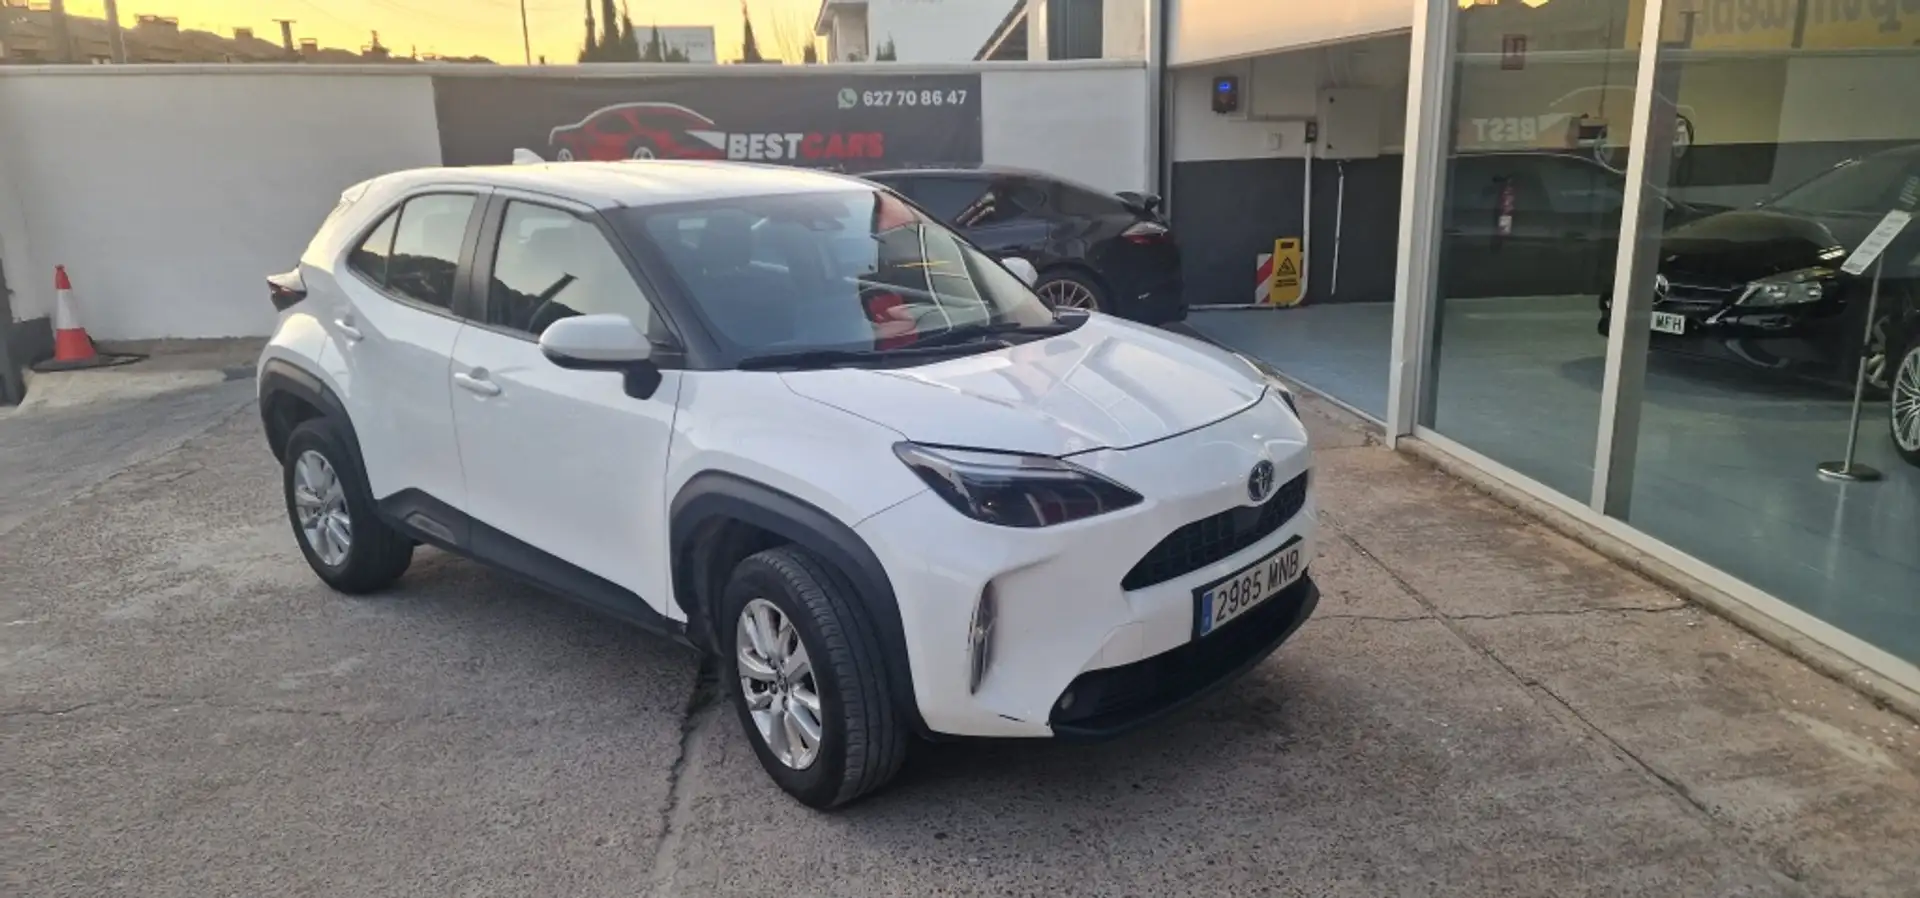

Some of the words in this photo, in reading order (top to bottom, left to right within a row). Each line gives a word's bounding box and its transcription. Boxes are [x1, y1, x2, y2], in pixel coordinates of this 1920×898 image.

[863, 90, 893, 106] 627
[896, 90, 917, 106] 70
[921, 90, 942, 106] 86
[947, 90, 967, 105] 47
[728, 131, 884, 160] BESTCARS
[1215, 571, 1263, 622] 2985
[1267, 550, 1299, 592] MNB
